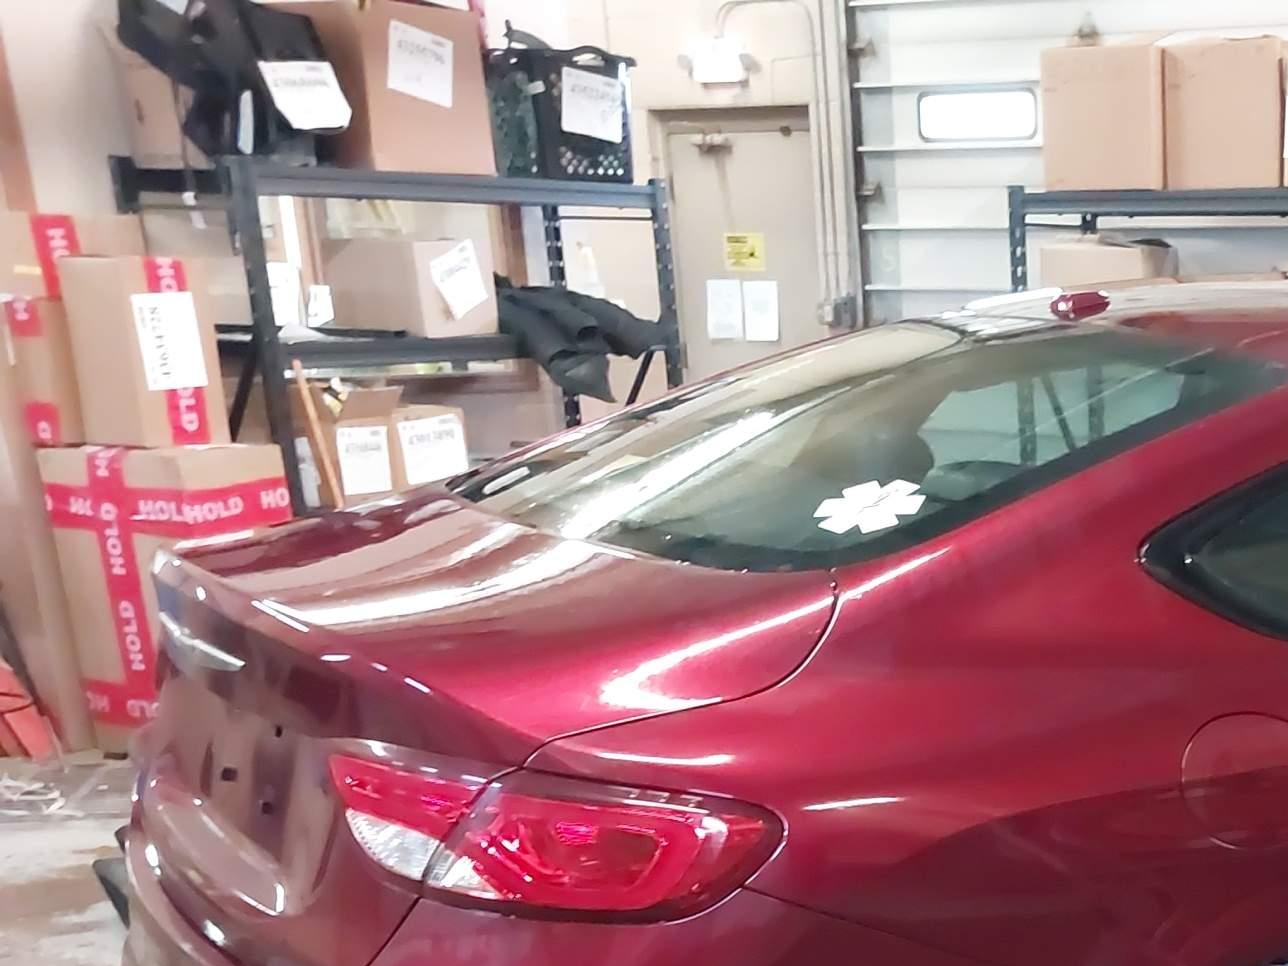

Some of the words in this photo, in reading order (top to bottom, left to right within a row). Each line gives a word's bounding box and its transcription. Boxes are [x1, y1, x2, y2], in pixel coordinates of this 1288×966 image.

[100, 502, 127, 575] HOLD
[180, 495, 244, 525] HOLD
[119, 600, 147, 671] HOLD
